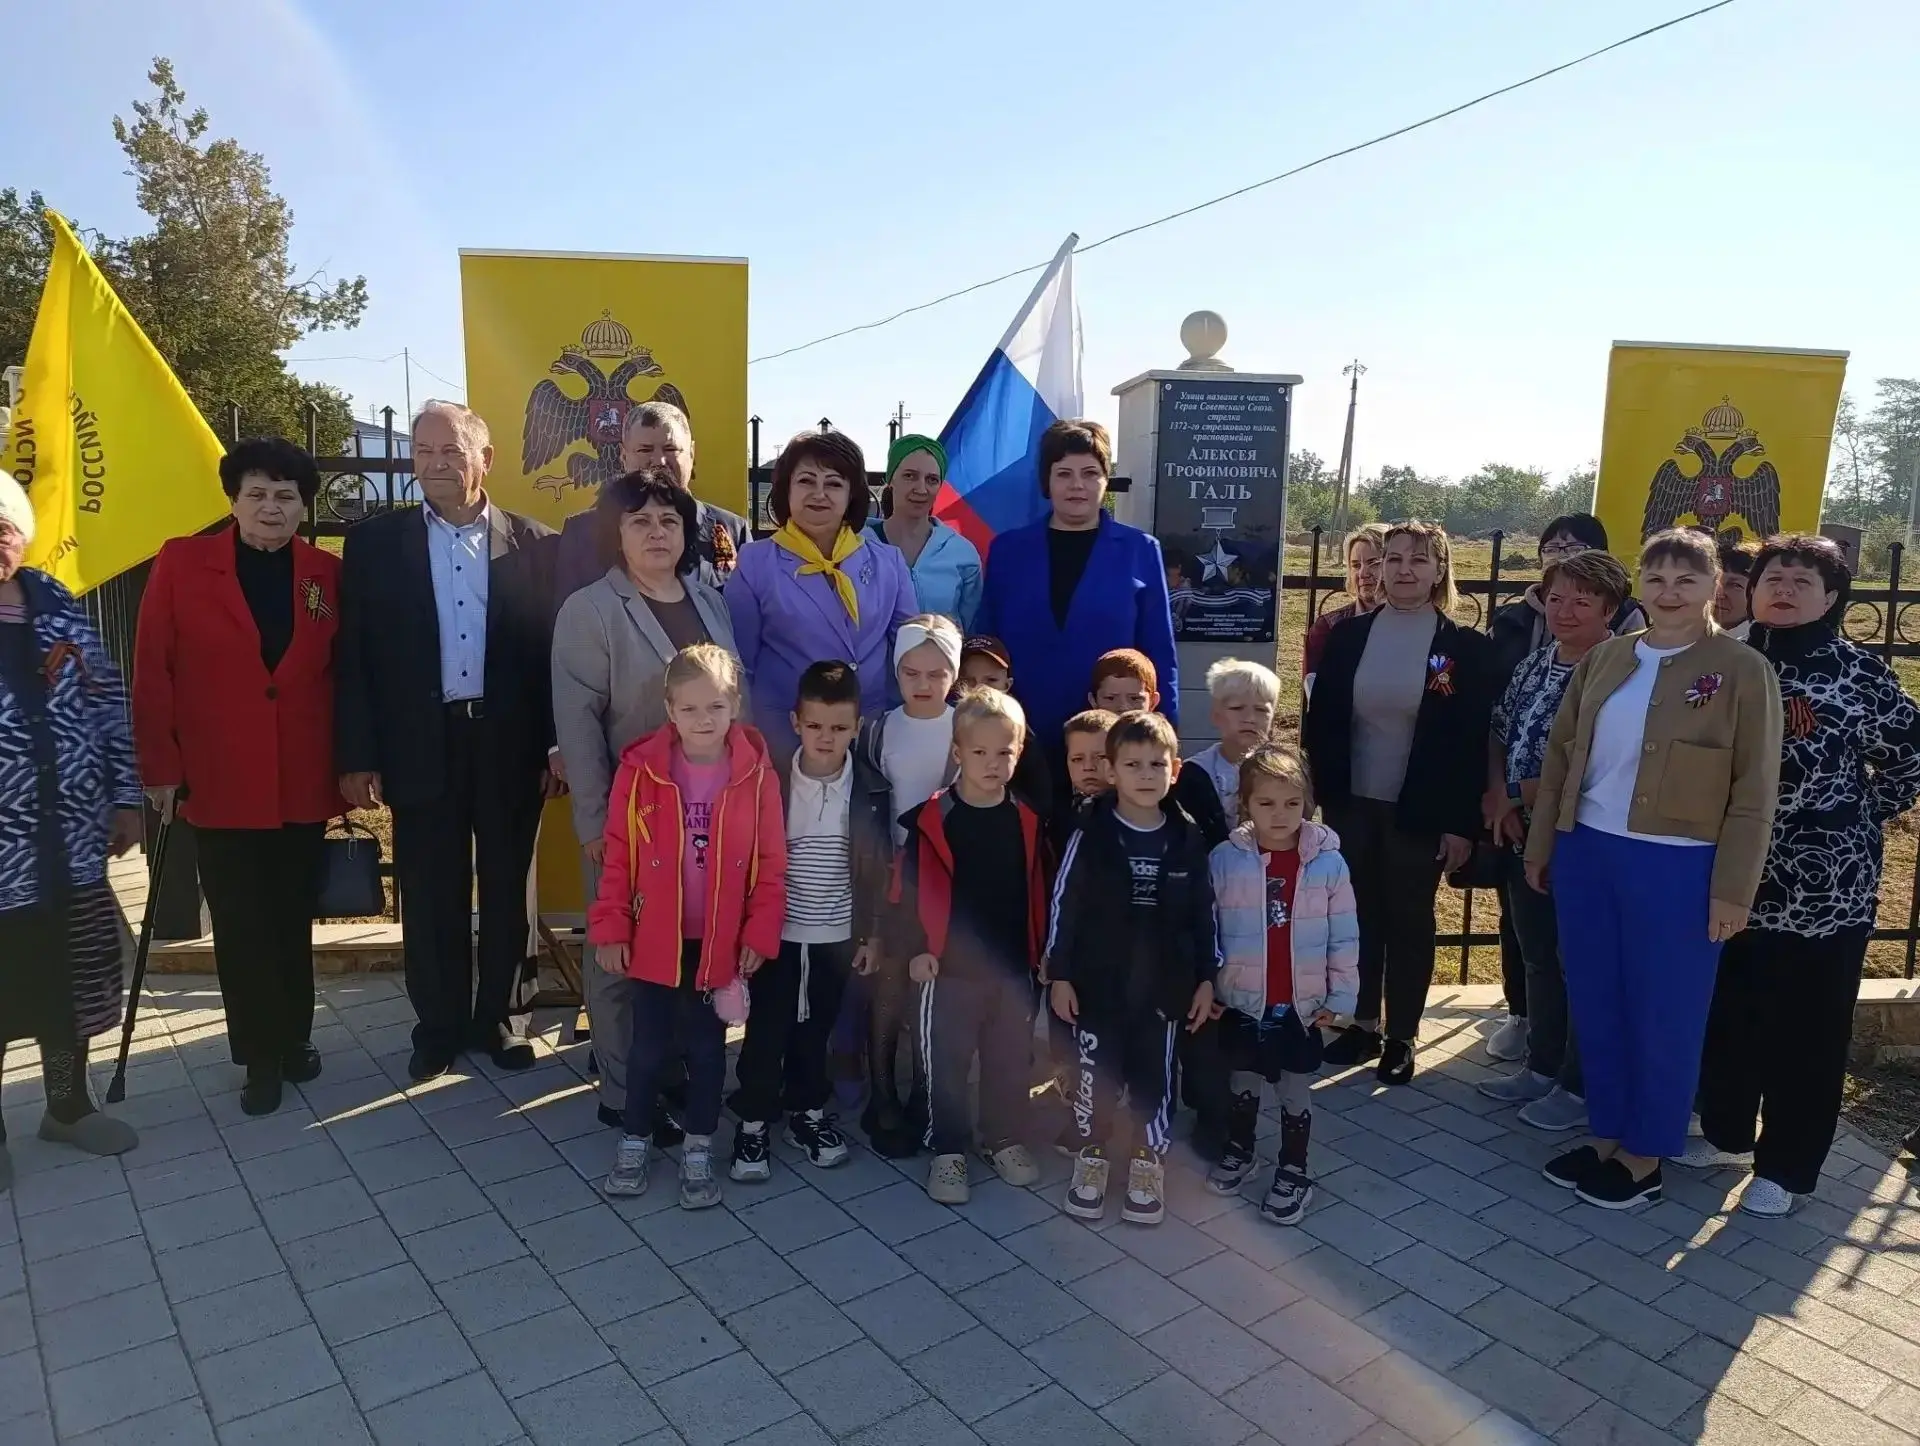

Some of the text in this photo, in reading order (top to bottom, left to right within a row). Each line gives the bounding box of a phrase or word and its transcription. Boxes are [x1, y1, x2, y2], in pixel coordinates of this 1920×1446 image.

[1180, 391, 1205, 402] Улица
[1246, 394, 1270, 402] честь
[1174, 401, 1197, 412] Героя
[1199, 402, 1245, 411] Советского
[1207, 414, 1241, 423] стрелка
[1169, 421, 1200, 430] 1372-го
[1201, 424, 1251, 433] стрелкового
[1192, 433, 1254, 443] красноармейца
[1187, 447, 1257, 461] АЛЕКСЕЯ
[1164, 462, 1278, 478] ТРОФИМОВИЧА
[1188, 480, 1252, 500] ГАЛЬ
[1074, 1069, 1094, 1137] adidas
